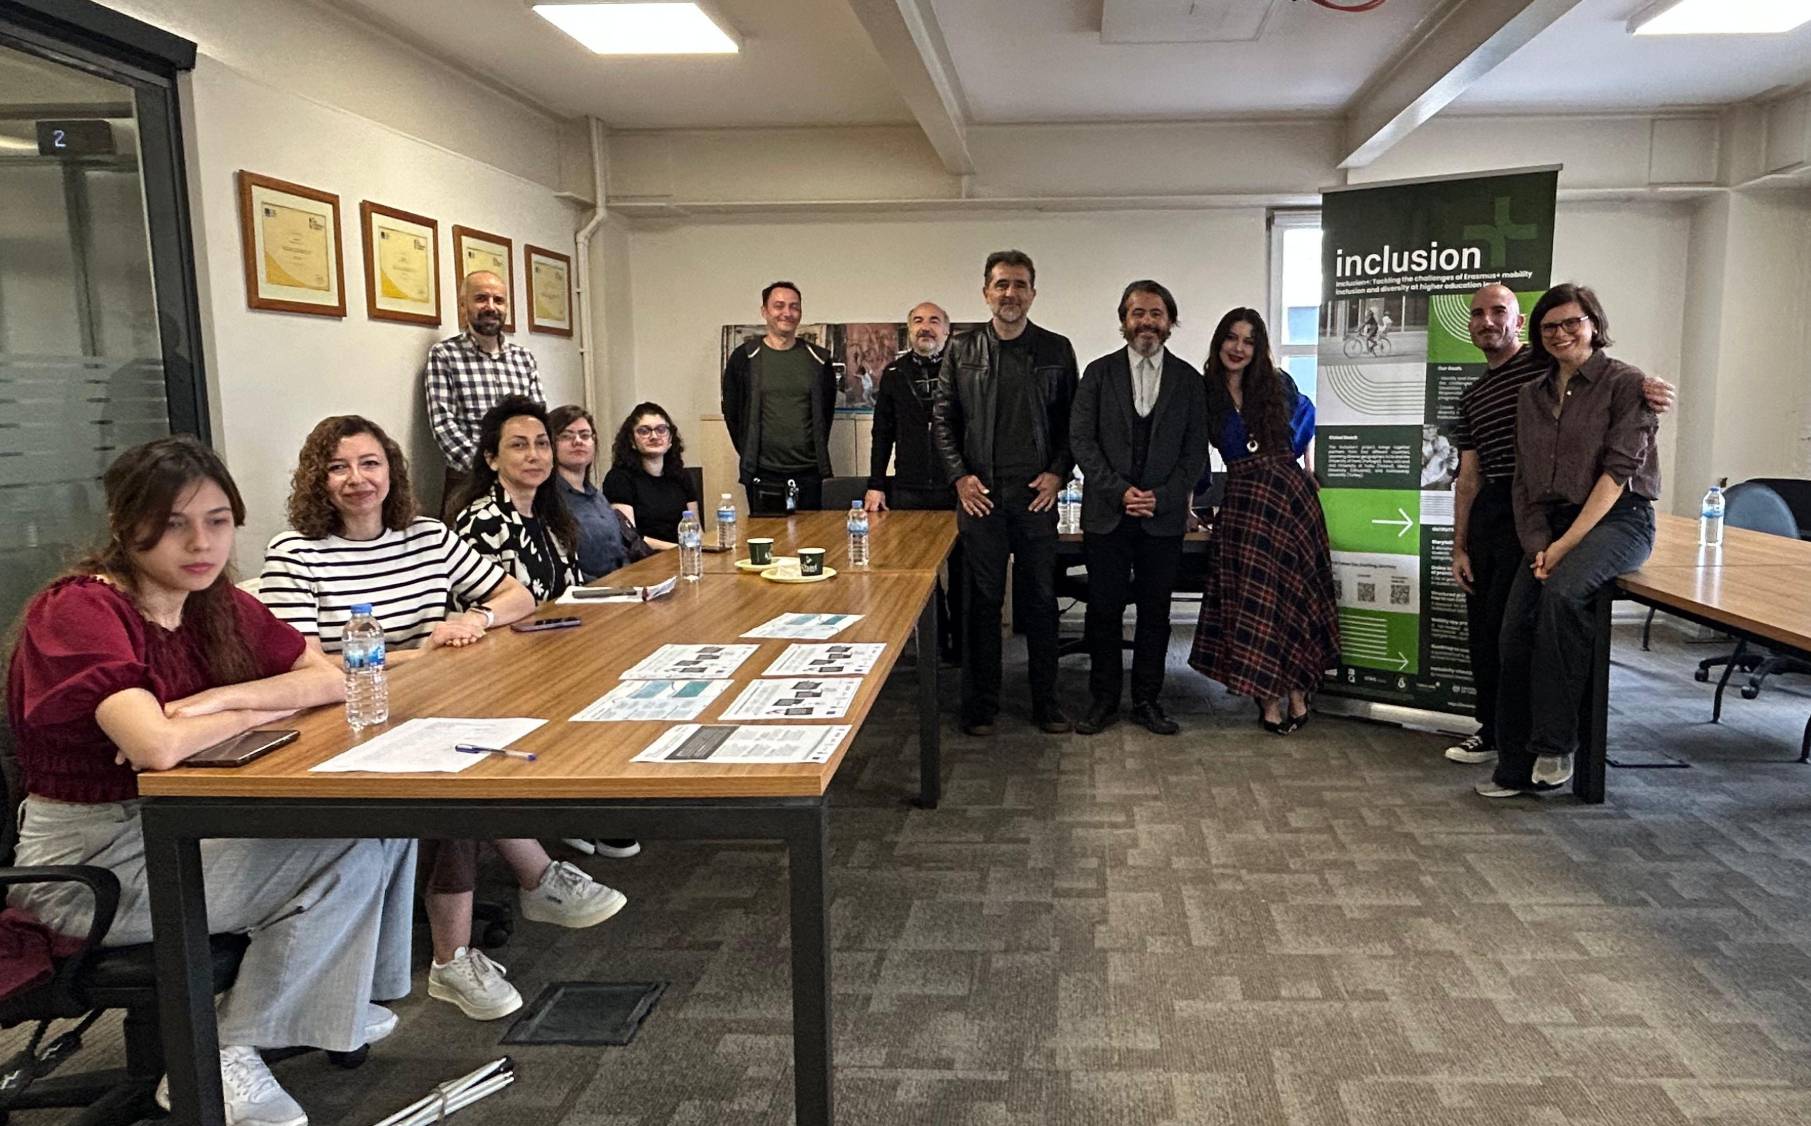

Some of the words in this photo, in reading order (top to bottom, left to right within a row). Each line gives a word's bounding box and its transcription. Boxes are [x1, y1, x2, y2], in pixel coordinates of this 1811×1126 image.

[53, 129, 67, 148] 2
[1336, 241, 1481, 277] inclusion
[1502, 270, 1532, 279] mobility
[1381, 284, 1409, 292] diversity
[1420, 282, 1443, 291] higher
[1444, 281, 1482, 289] education
